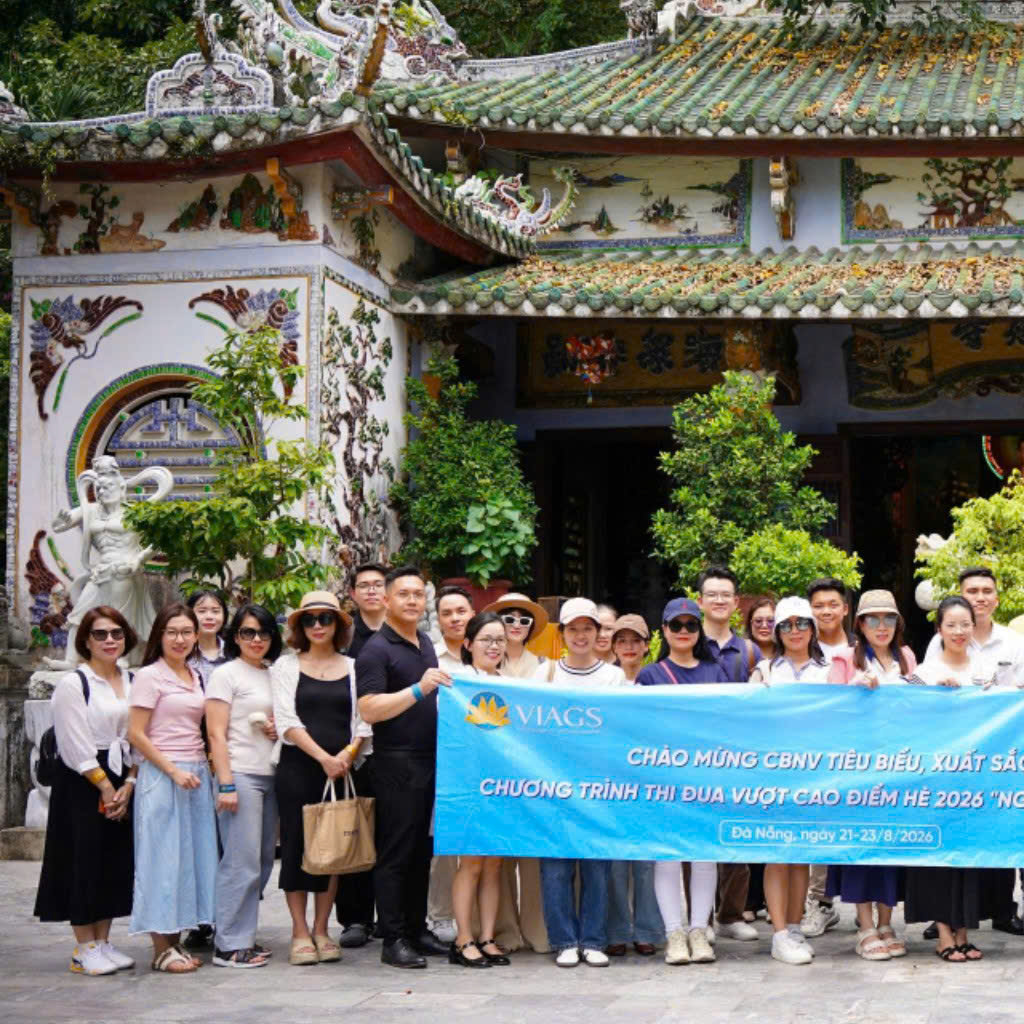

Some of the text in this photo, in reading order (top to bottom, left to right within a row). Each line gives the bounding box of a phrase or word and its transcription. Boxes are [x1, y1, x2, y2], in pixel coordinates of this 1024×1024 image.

[514, 704, 603, 728] VIAGS
[627, 744, 689, 767] CHÀO
[763, 751, 822, 770] CBNV
[827, 749, 871, 771] TIÊU
[932, 749, 987, 772] XUẤT
[479, 778, 573, 800] CHƯƠNG
[579, 777, 639, 801] TRÌNH
[644, 783, 676, 802] THI
[681, 785, 726, 804] ĐUA
[731, 786, 790, 810] VƯỢT
[793, 788, 841, 806] CAO
[846, 782, 898, 807] ĐIỂM
[903, 786, 931, 807] HÈ
[933, 790, 985, 809] 2026
[731, 825, 750, 839] Đà
[800, 828, 836, 843] ngày
[839, 827, 934, 843] 21-23/8/2026
